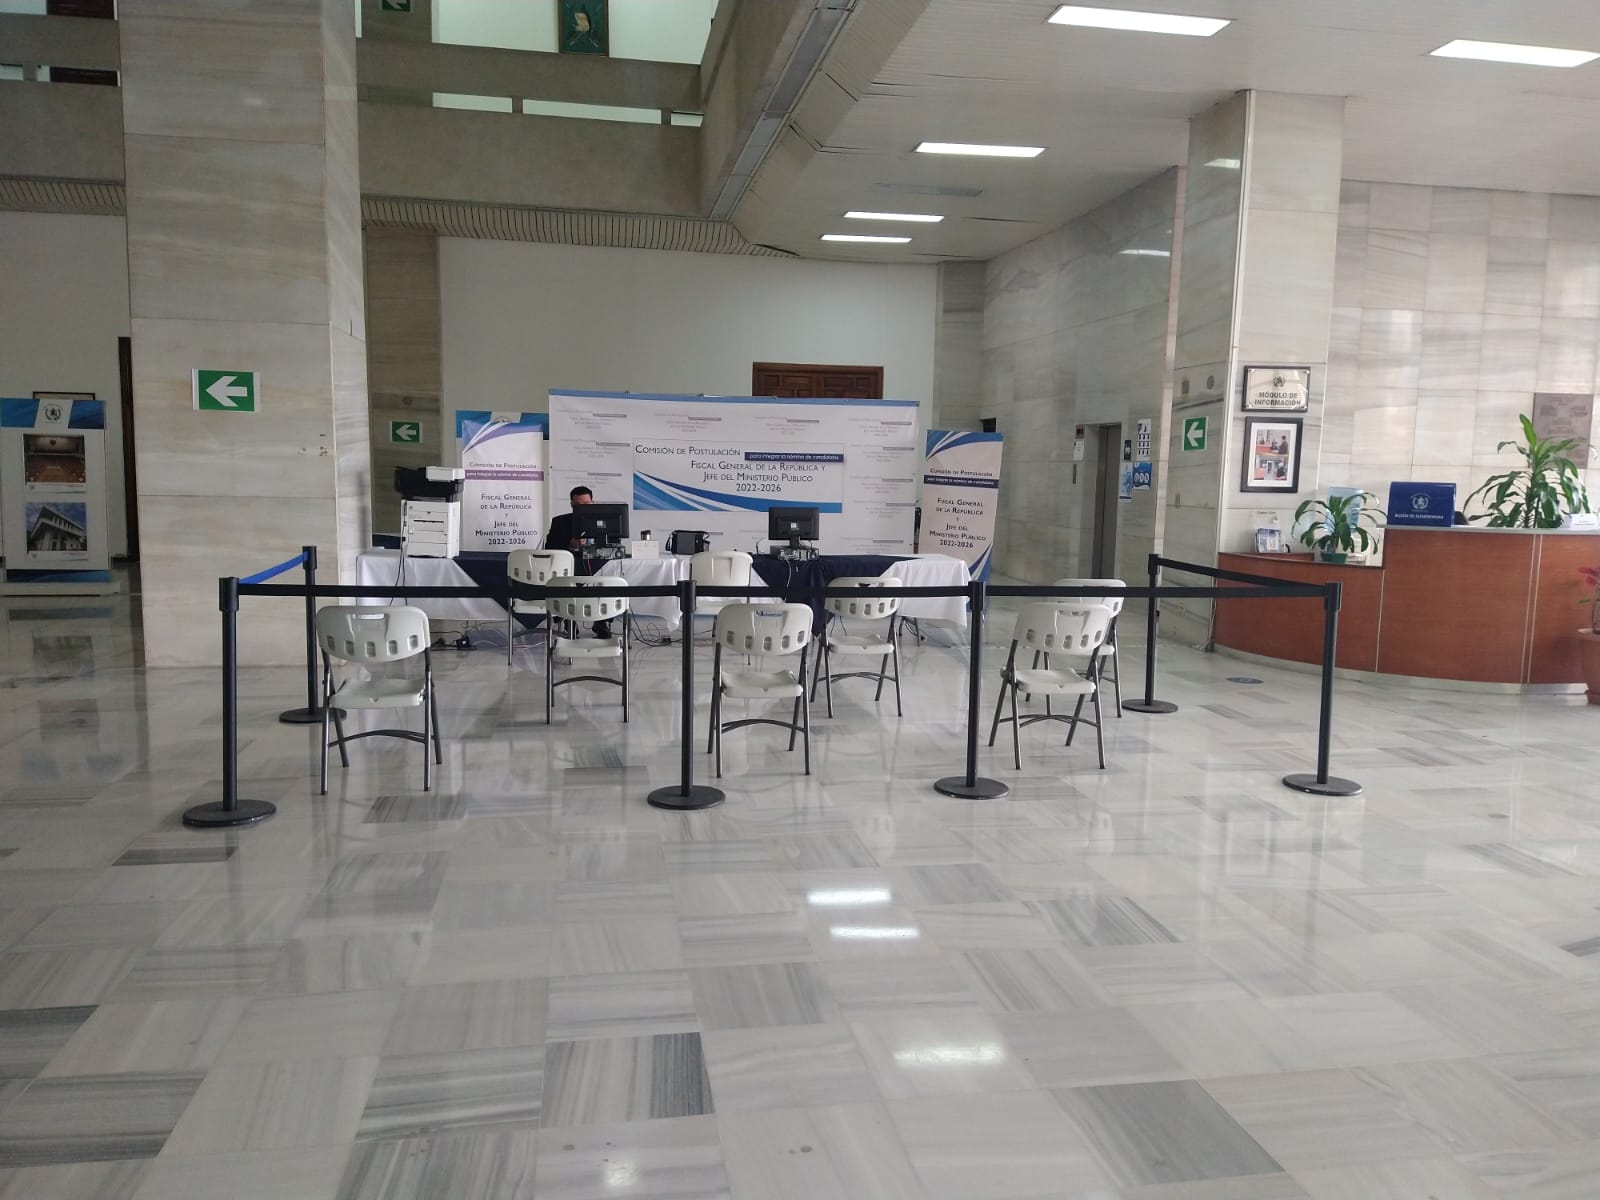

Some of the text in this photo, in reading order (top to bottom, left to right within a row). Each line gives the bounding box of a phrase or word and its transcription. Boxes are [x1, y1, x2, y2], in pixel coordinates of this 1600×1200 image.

[676, 447, 687, 455] DE
[689, 446, 741, 456] POSTULACIÓN
[691, 460, 716, 470] FISCAL
[718, 461, 753, 471] GENERAL
[755, 463, 766, 471] DE
[780, 462, 819, 471] REPÚBLICA
[703, 471, 719, 482] JEFE
[720, 473, 734, 481] DEL
[736, 472, 779, 482] MINISTERIO
[736, 483, 782, 493] 2022-2026
[957, 499, 983, 507] GENERAL
[475, 529, 510, 537] MINISTERIO
[929, 530, 959, 539] MINISTERIO
[940, 540, 973, 548] 2022-2026
